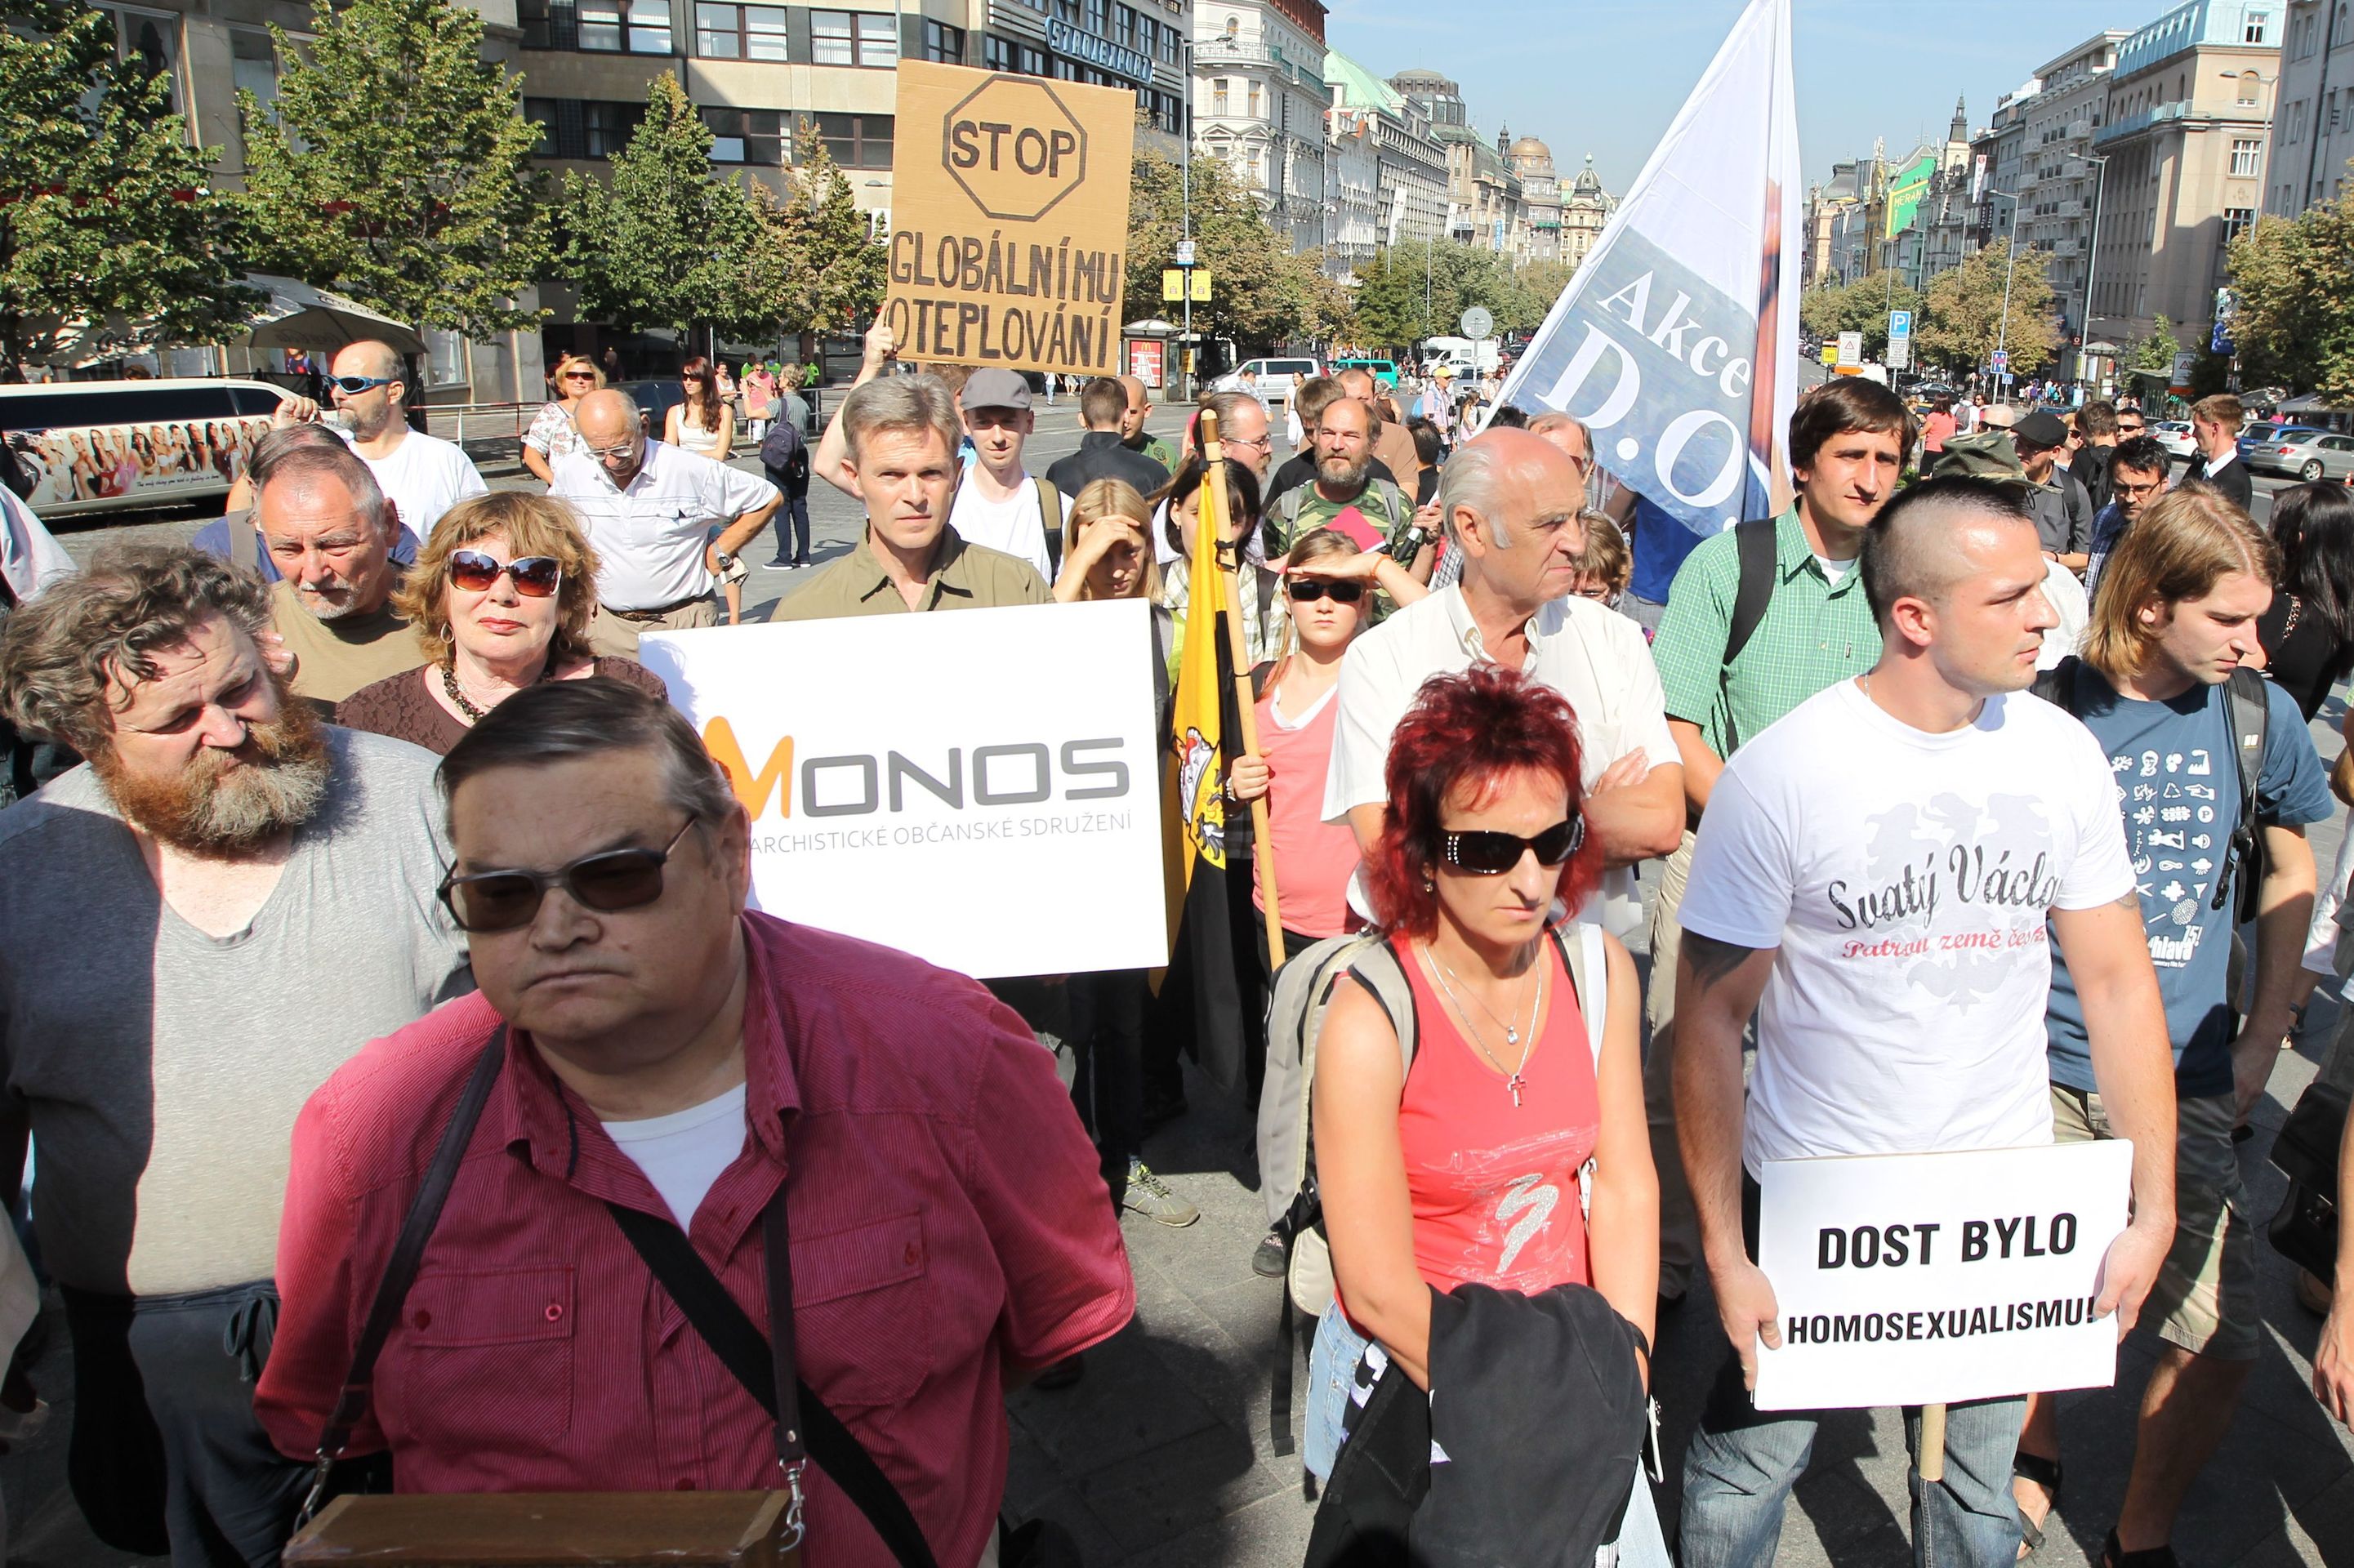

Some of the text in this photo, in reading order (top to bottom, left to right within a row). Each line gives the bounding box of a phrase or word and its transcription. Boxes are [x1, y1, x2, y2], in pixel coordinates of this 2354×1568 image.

[952, 119, 1076, 179] STOP
[890, 229, 1120, 304] GLOBÁLNÍMU
[887, 296, 1112, 369] OTEPLOVÁNÍ
[1596, 270, 1751, 399] Akce
[1893, 314, 1906, 331] P
[702, 715, 1130, 822] MONOS
[750, 808, 1131, 855] ARCHISTICKÉ OBČANSKÉ SDRUŽENÍ
[1828, 844, 2065, 929] Svatý Václa
[1842, 924, 2047, 959] Patron země česk
[1818, 1213, 2078, 1270] DOST BYLO
[1787, 1295, 2096, 1345] HOMOSEXUALISMU!
